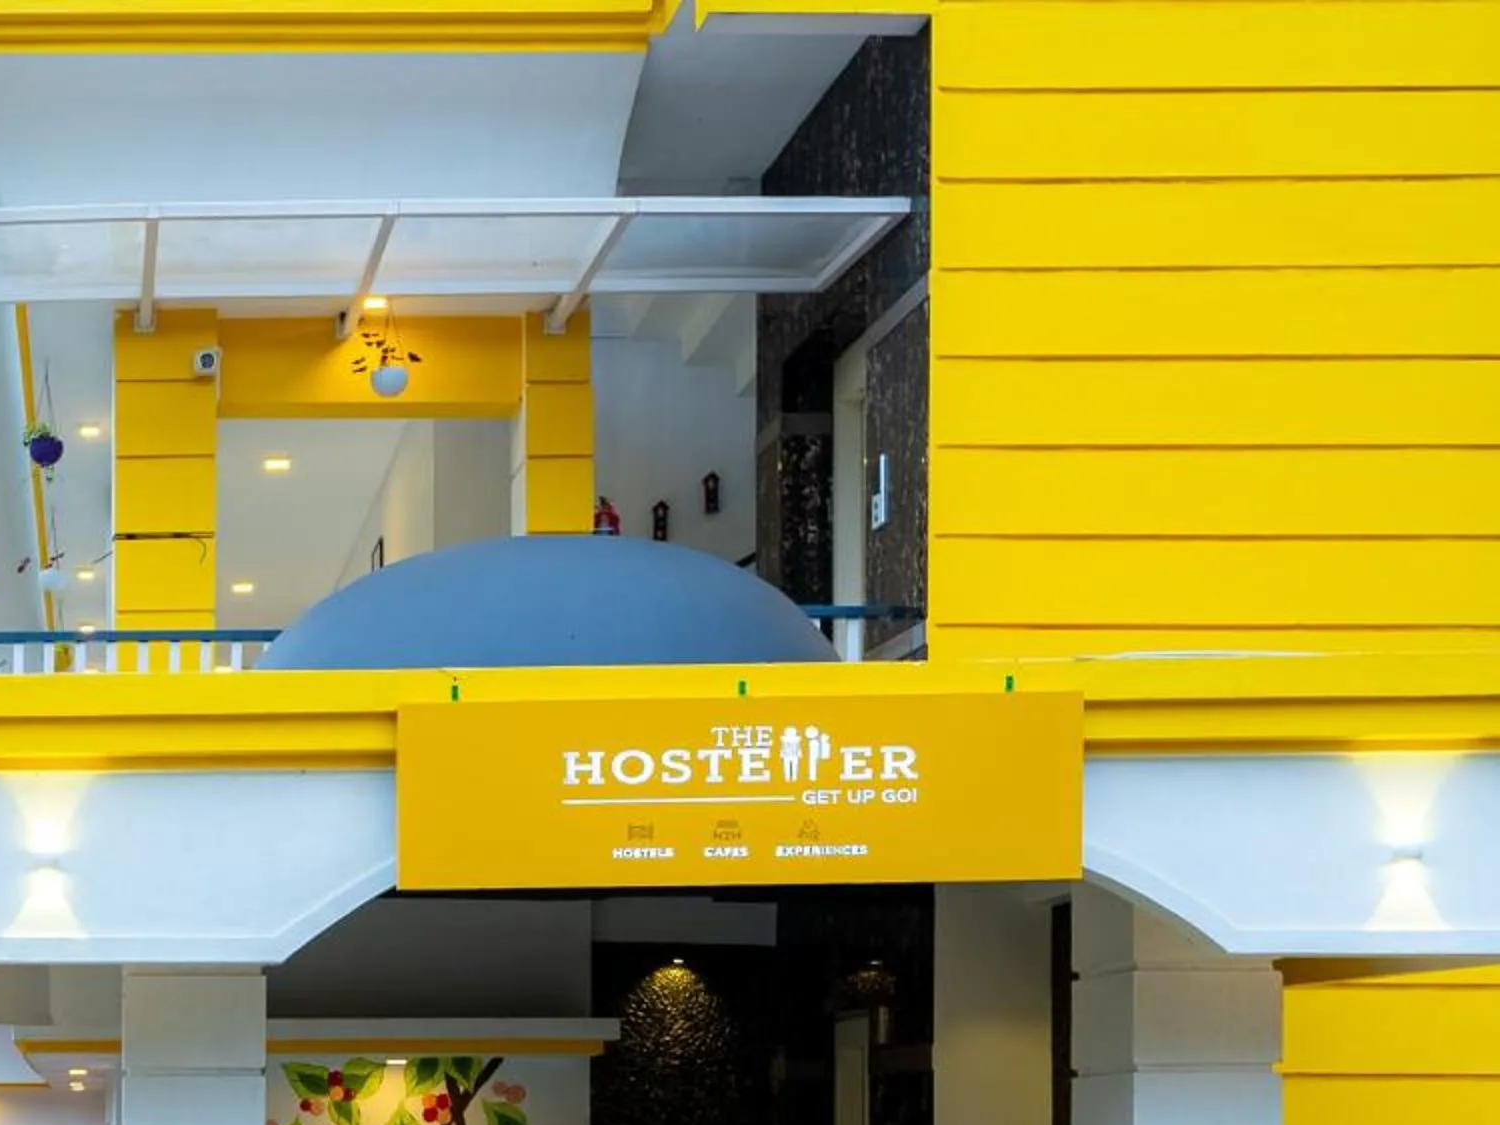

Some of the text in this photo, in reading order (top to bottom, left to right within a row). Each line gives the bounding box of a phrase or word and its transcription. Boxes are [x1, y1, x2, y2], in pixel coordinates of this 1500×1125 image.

[711, 725, 773, 747] THE
[801, 788, 842, 805] GET
[847, 788, 876, 804] UP
[611, 847, 675, 860] HOSTELS
[775, 844, 869, 858] EXPERIENCES
